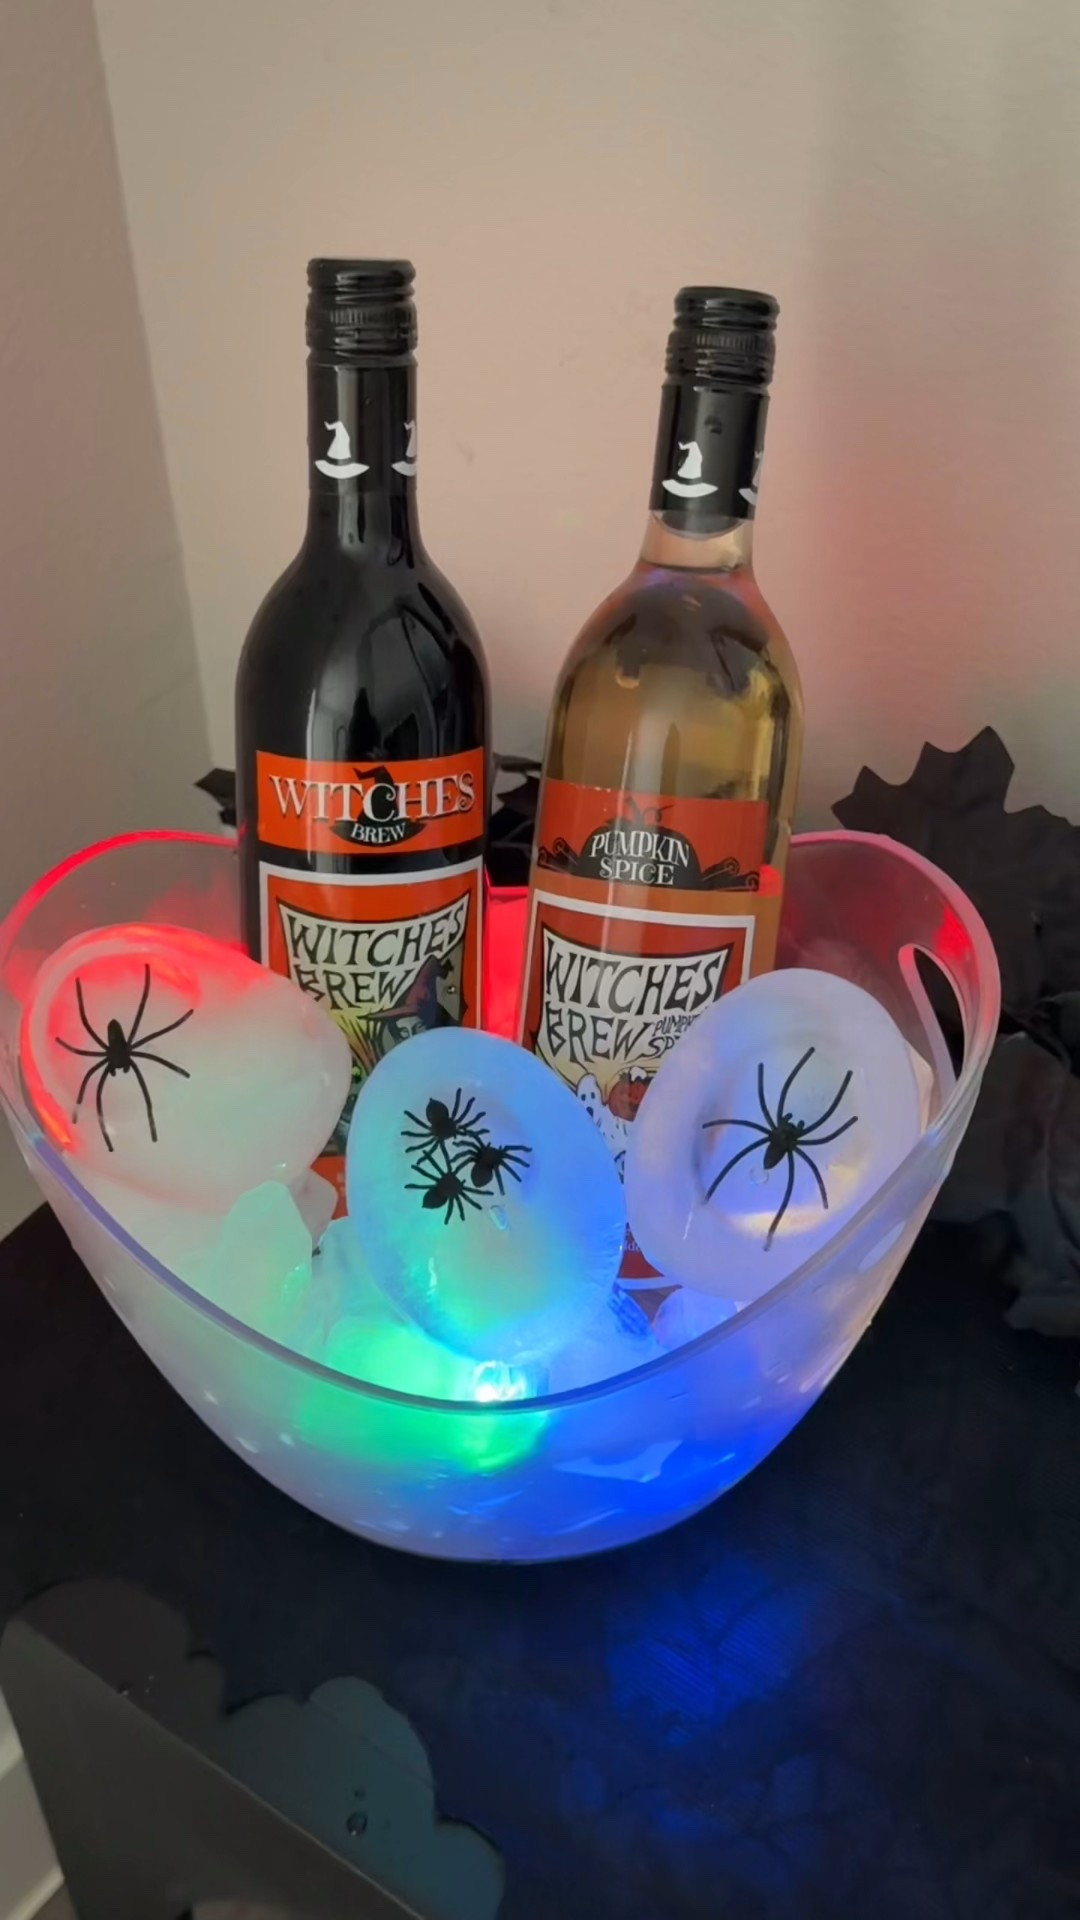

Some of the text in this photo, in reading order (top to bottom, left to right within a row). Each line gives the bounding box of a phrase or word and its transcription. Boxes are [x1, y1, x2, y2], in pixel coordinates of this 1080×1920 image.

[269, 770, 476, 823] WITCHES
[350, 822, 406, 844] BREW
[588, 829, 690, 868] PUMPKIN
[600, 855, 675, 886] SPICE
[286, 902, 465, 967] WITCHES
[293, 964, 417, 1010] BREW
[546, 936, 721, 1016] WITCHES
[544, 1000, 650, 1064] BREW
